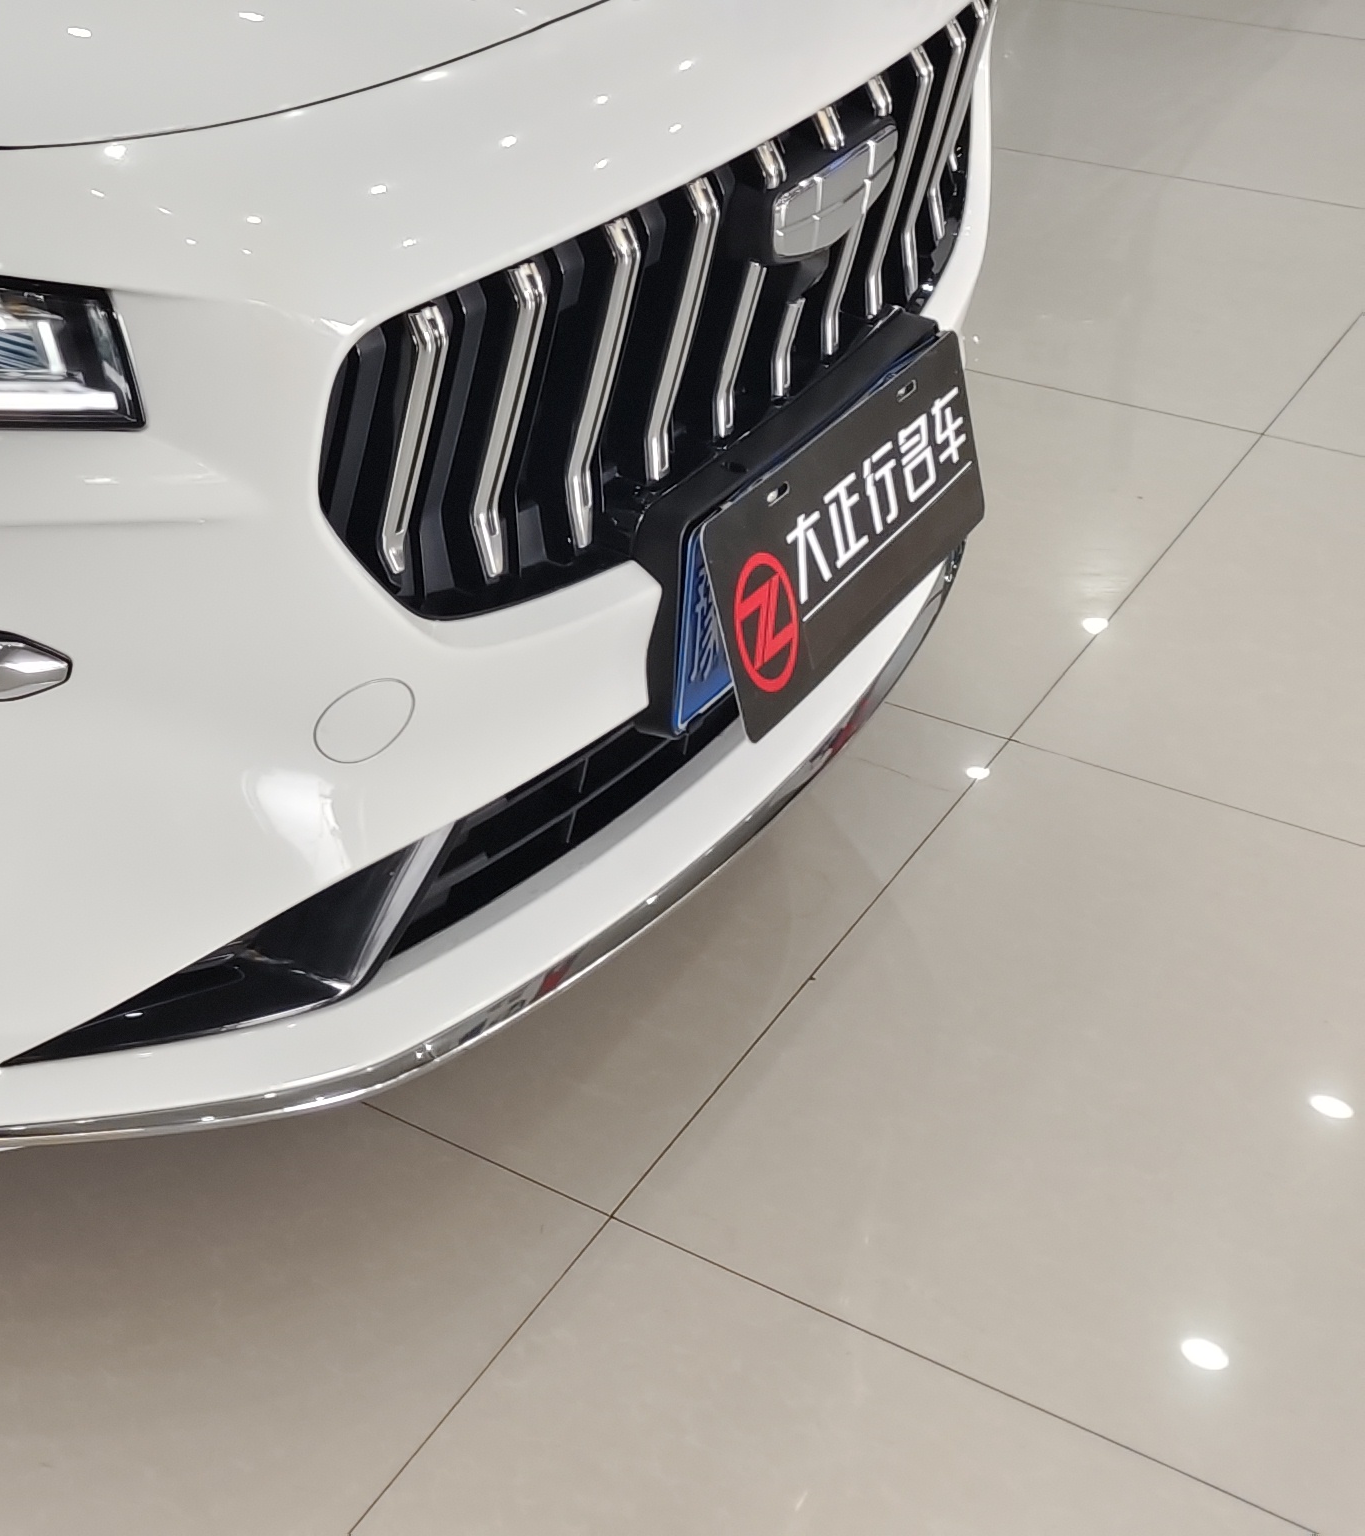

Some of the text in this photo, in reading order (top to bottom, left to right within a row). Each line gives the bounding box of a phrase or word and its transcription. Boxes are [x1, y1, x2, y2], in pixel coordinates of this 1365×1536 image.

[785, 385, 969, 606] 大正行名车
